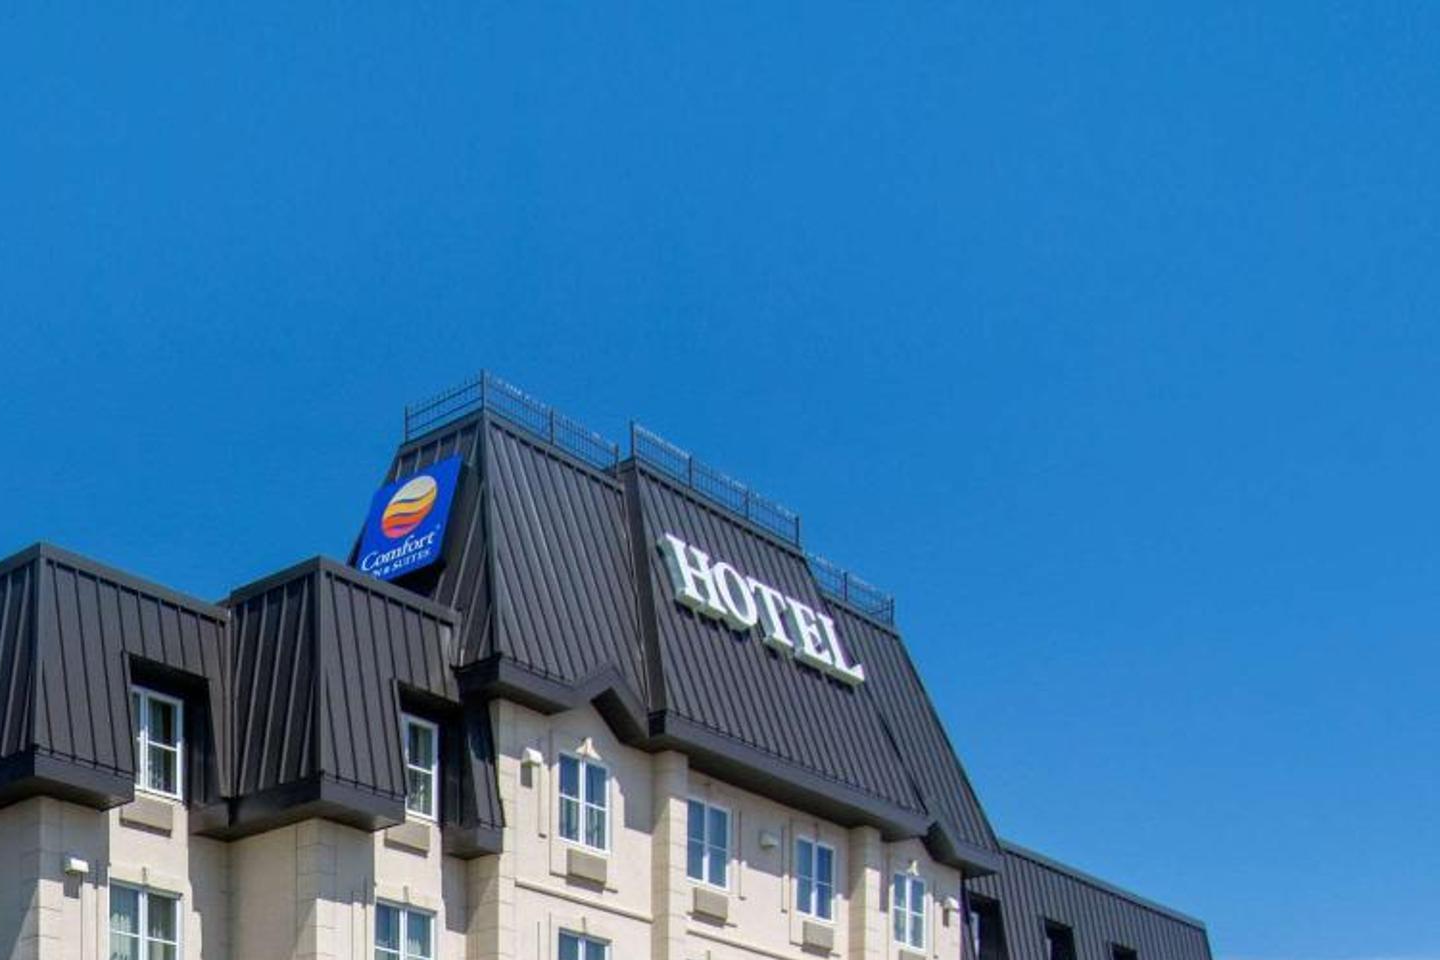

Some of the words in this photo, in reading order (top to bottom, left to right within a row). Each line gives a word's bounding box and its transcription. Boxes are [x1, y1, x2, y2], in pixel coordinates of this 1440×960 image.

[361, 531, 435, 571] Comfort
[392, 549, 430, 569] SUITES
[663, 533, 864, 681] HOTEL
